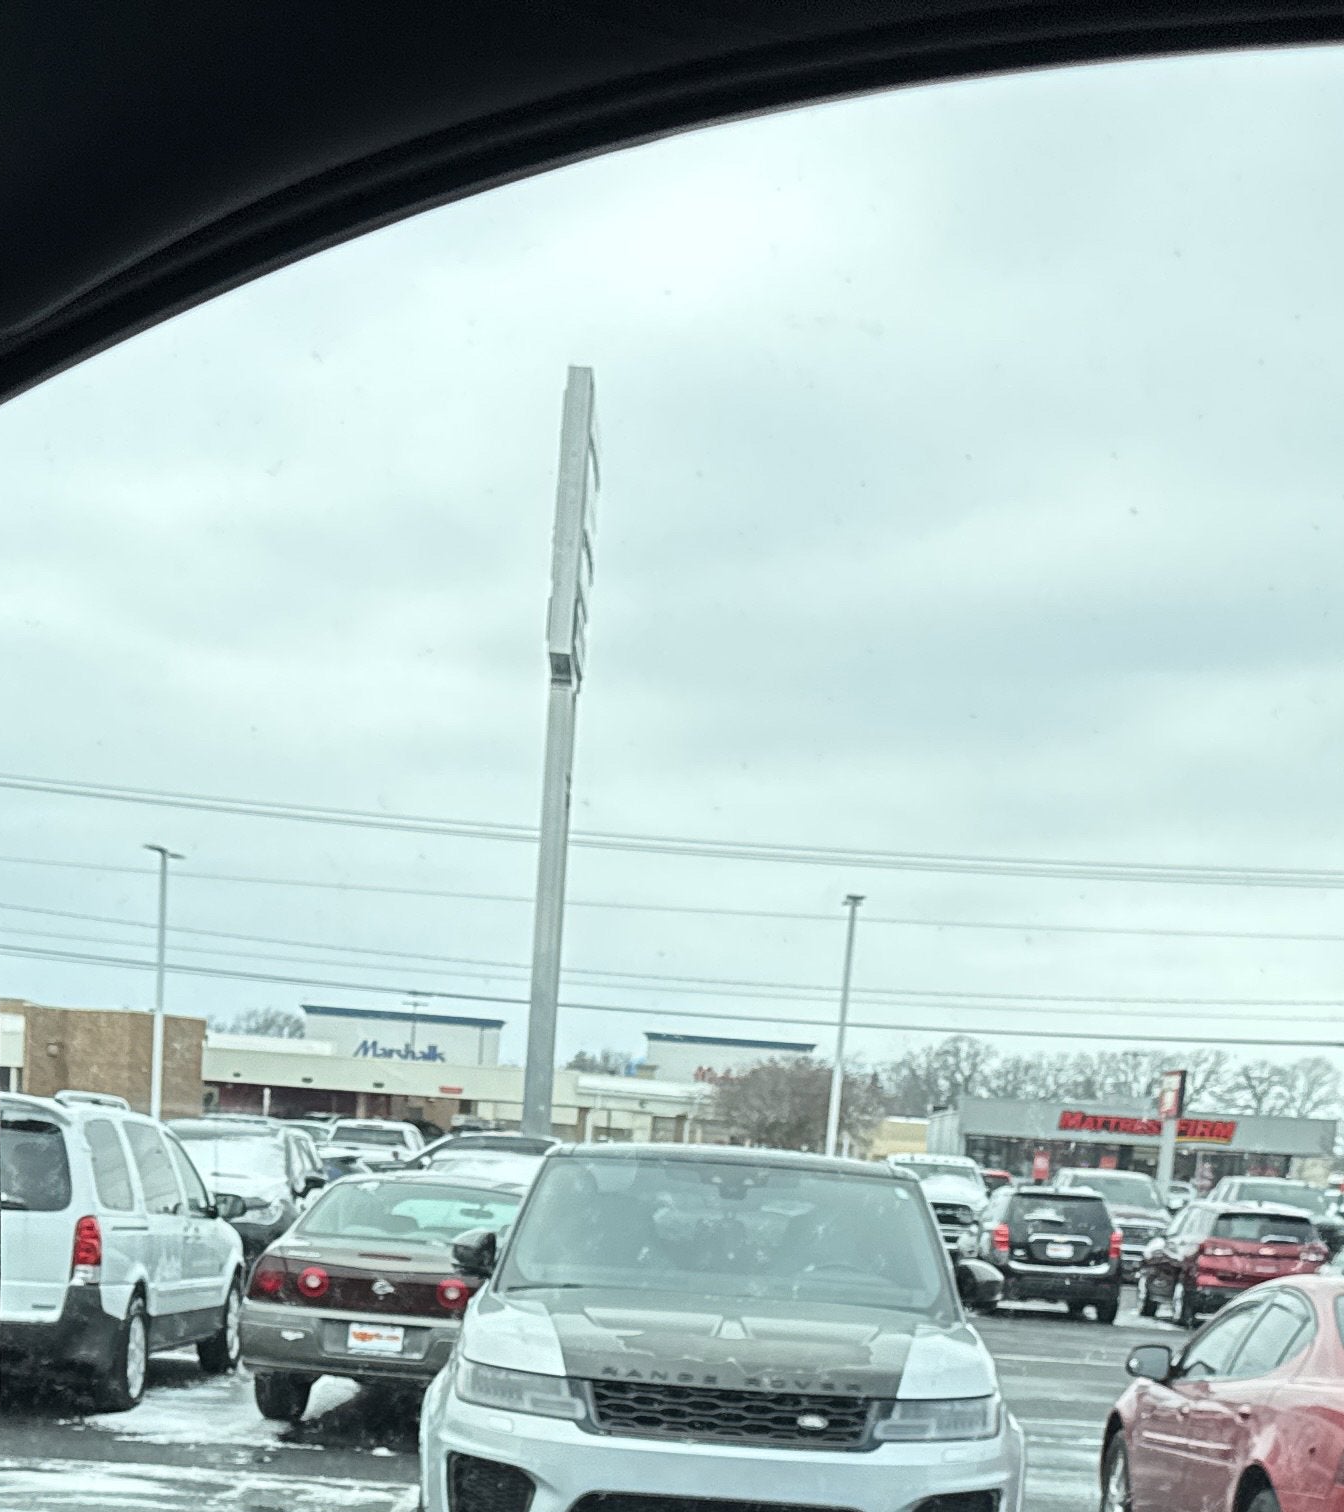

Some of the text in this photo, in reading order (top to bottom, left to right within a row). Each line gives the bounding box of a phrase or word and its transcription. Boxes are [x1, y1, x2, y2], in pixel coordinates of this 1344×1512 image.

[1175, 1118, 1236, 1140] FIRM
[601, 1366, 862, 1392] RANGE ROVER
